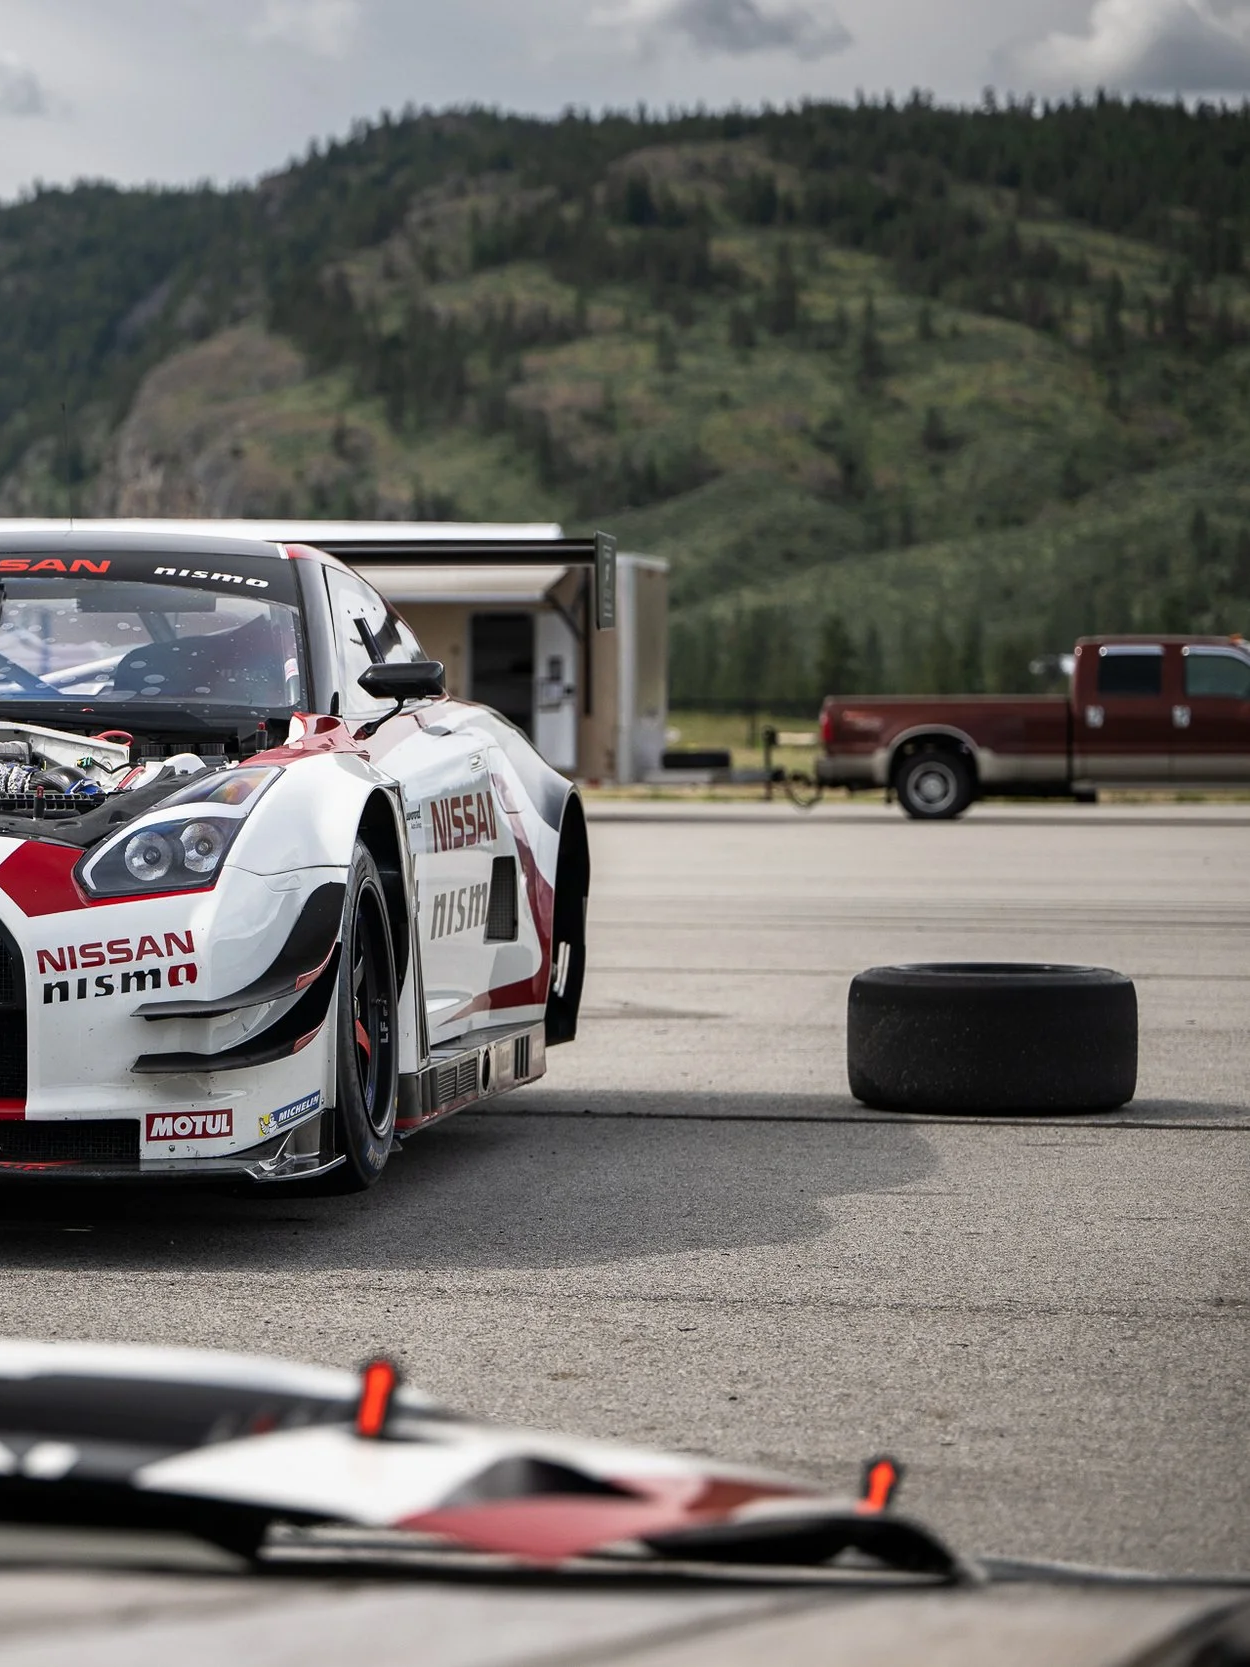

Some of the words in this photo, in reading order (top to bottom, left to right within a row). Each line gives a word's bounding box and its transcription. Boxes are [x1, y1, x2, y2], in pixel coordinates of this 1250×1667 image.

[154, 566, 269, 588] nismo
[36, 930, 195, 975] NISSAN
[43, 962, 197, 1005] nismo
[278, 1094, 319, 1122] MICHELIN
[150, 1113, 230, 1138] MOTUL
